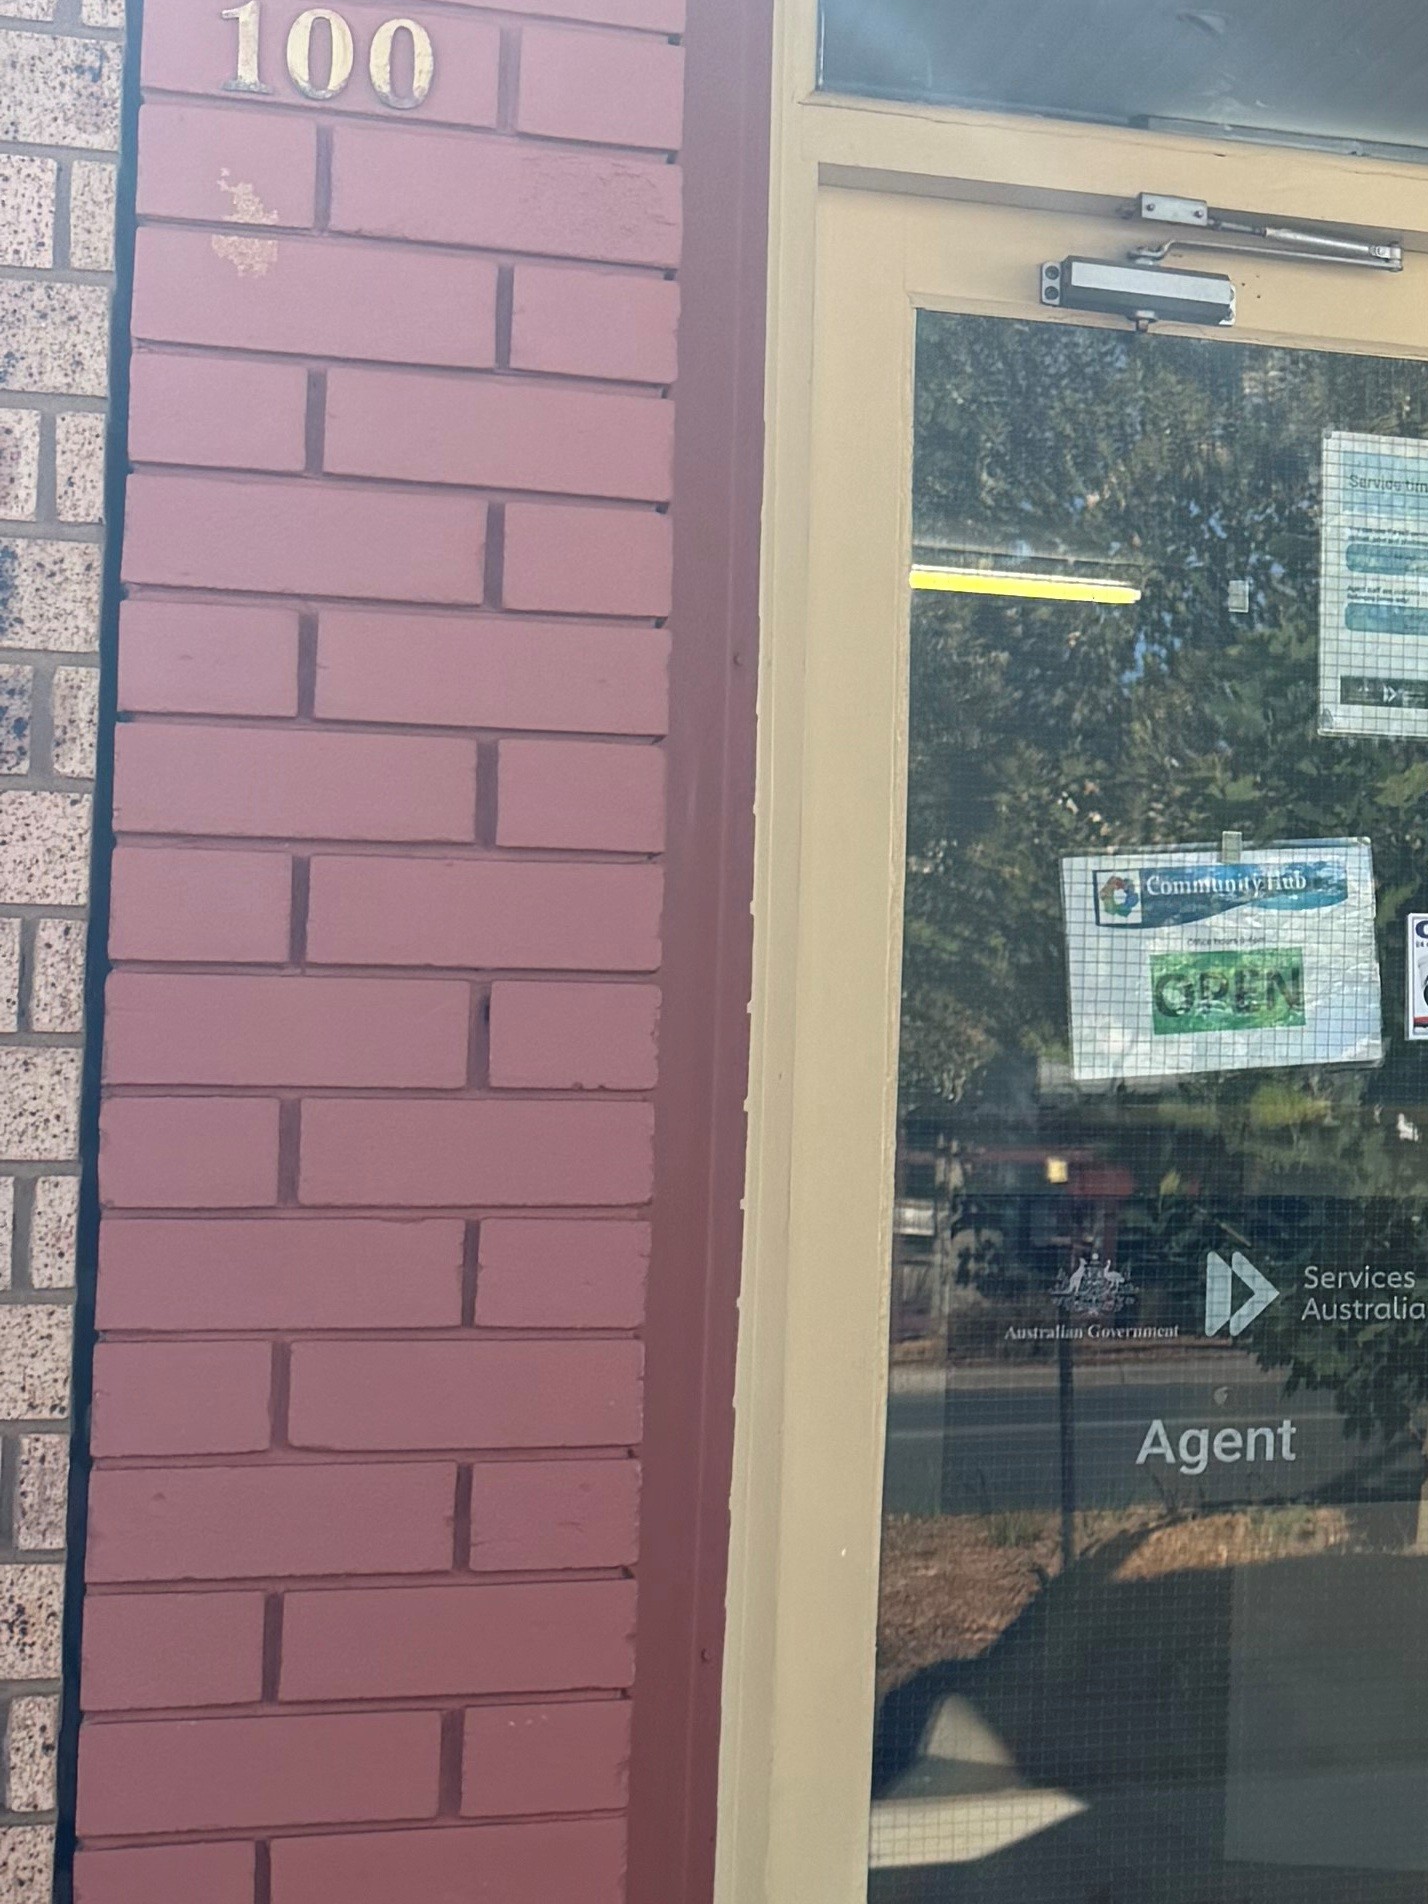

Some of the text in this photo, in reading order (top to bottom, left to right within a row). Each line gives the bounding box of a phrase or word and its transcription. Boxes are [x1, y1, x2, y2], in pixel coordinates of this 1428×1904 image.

[219, 0, 435, 110] 100
[1147, 870, 1307, 898] Community Hub
[1155, 968, 1301, 1018] OPEN
[1304, 1265, 1417, 1290] Services
[1301, 1297, 1427, 1322] Australia
[1004, 1324, 1180, 1340] Australian Government
[1135, 1419, 1297, 1475] Agent
